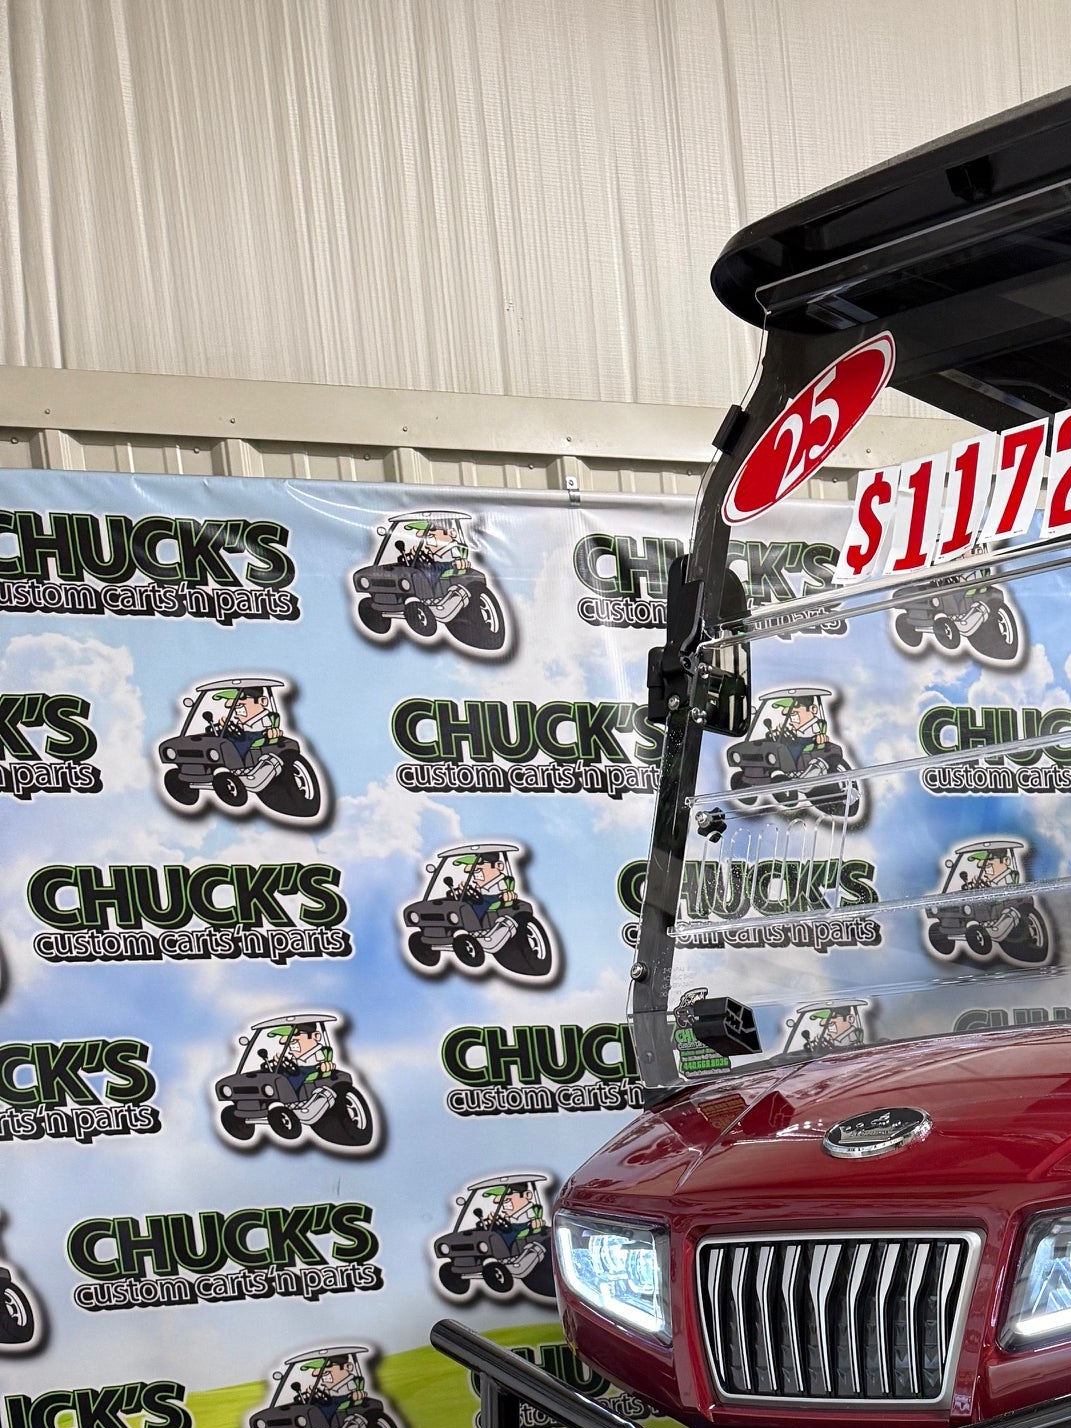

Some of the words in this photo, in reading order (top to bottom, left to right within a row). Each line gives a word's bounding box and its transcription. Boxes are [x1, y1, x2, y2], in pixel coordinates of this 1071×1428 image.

[774, 366, 840, 499] 25
[212, 587, 298, 624] parts
[391, 698, 667, 763] CHUCK'S
[10, 761, 102, 799] parts
[397, 762, 505, 792] custom
[605, 763, 661, 799] part
[923, 765, 1015, 792] custom
[27, 863, 347, 928] CHUCK'S
[34, 929, 158, 961] custom
[268, 927, 350, 964] parts
[812, 916, 880, 951] parts
[447, 1085, 554, 1114] custom
[72, 1103, 159, 1142] parts
[68, 1203, 378, 1279] CHUCK'S
[74, 1276, 193, 1309] custom
[301, 1262, 381, 1299] parts
